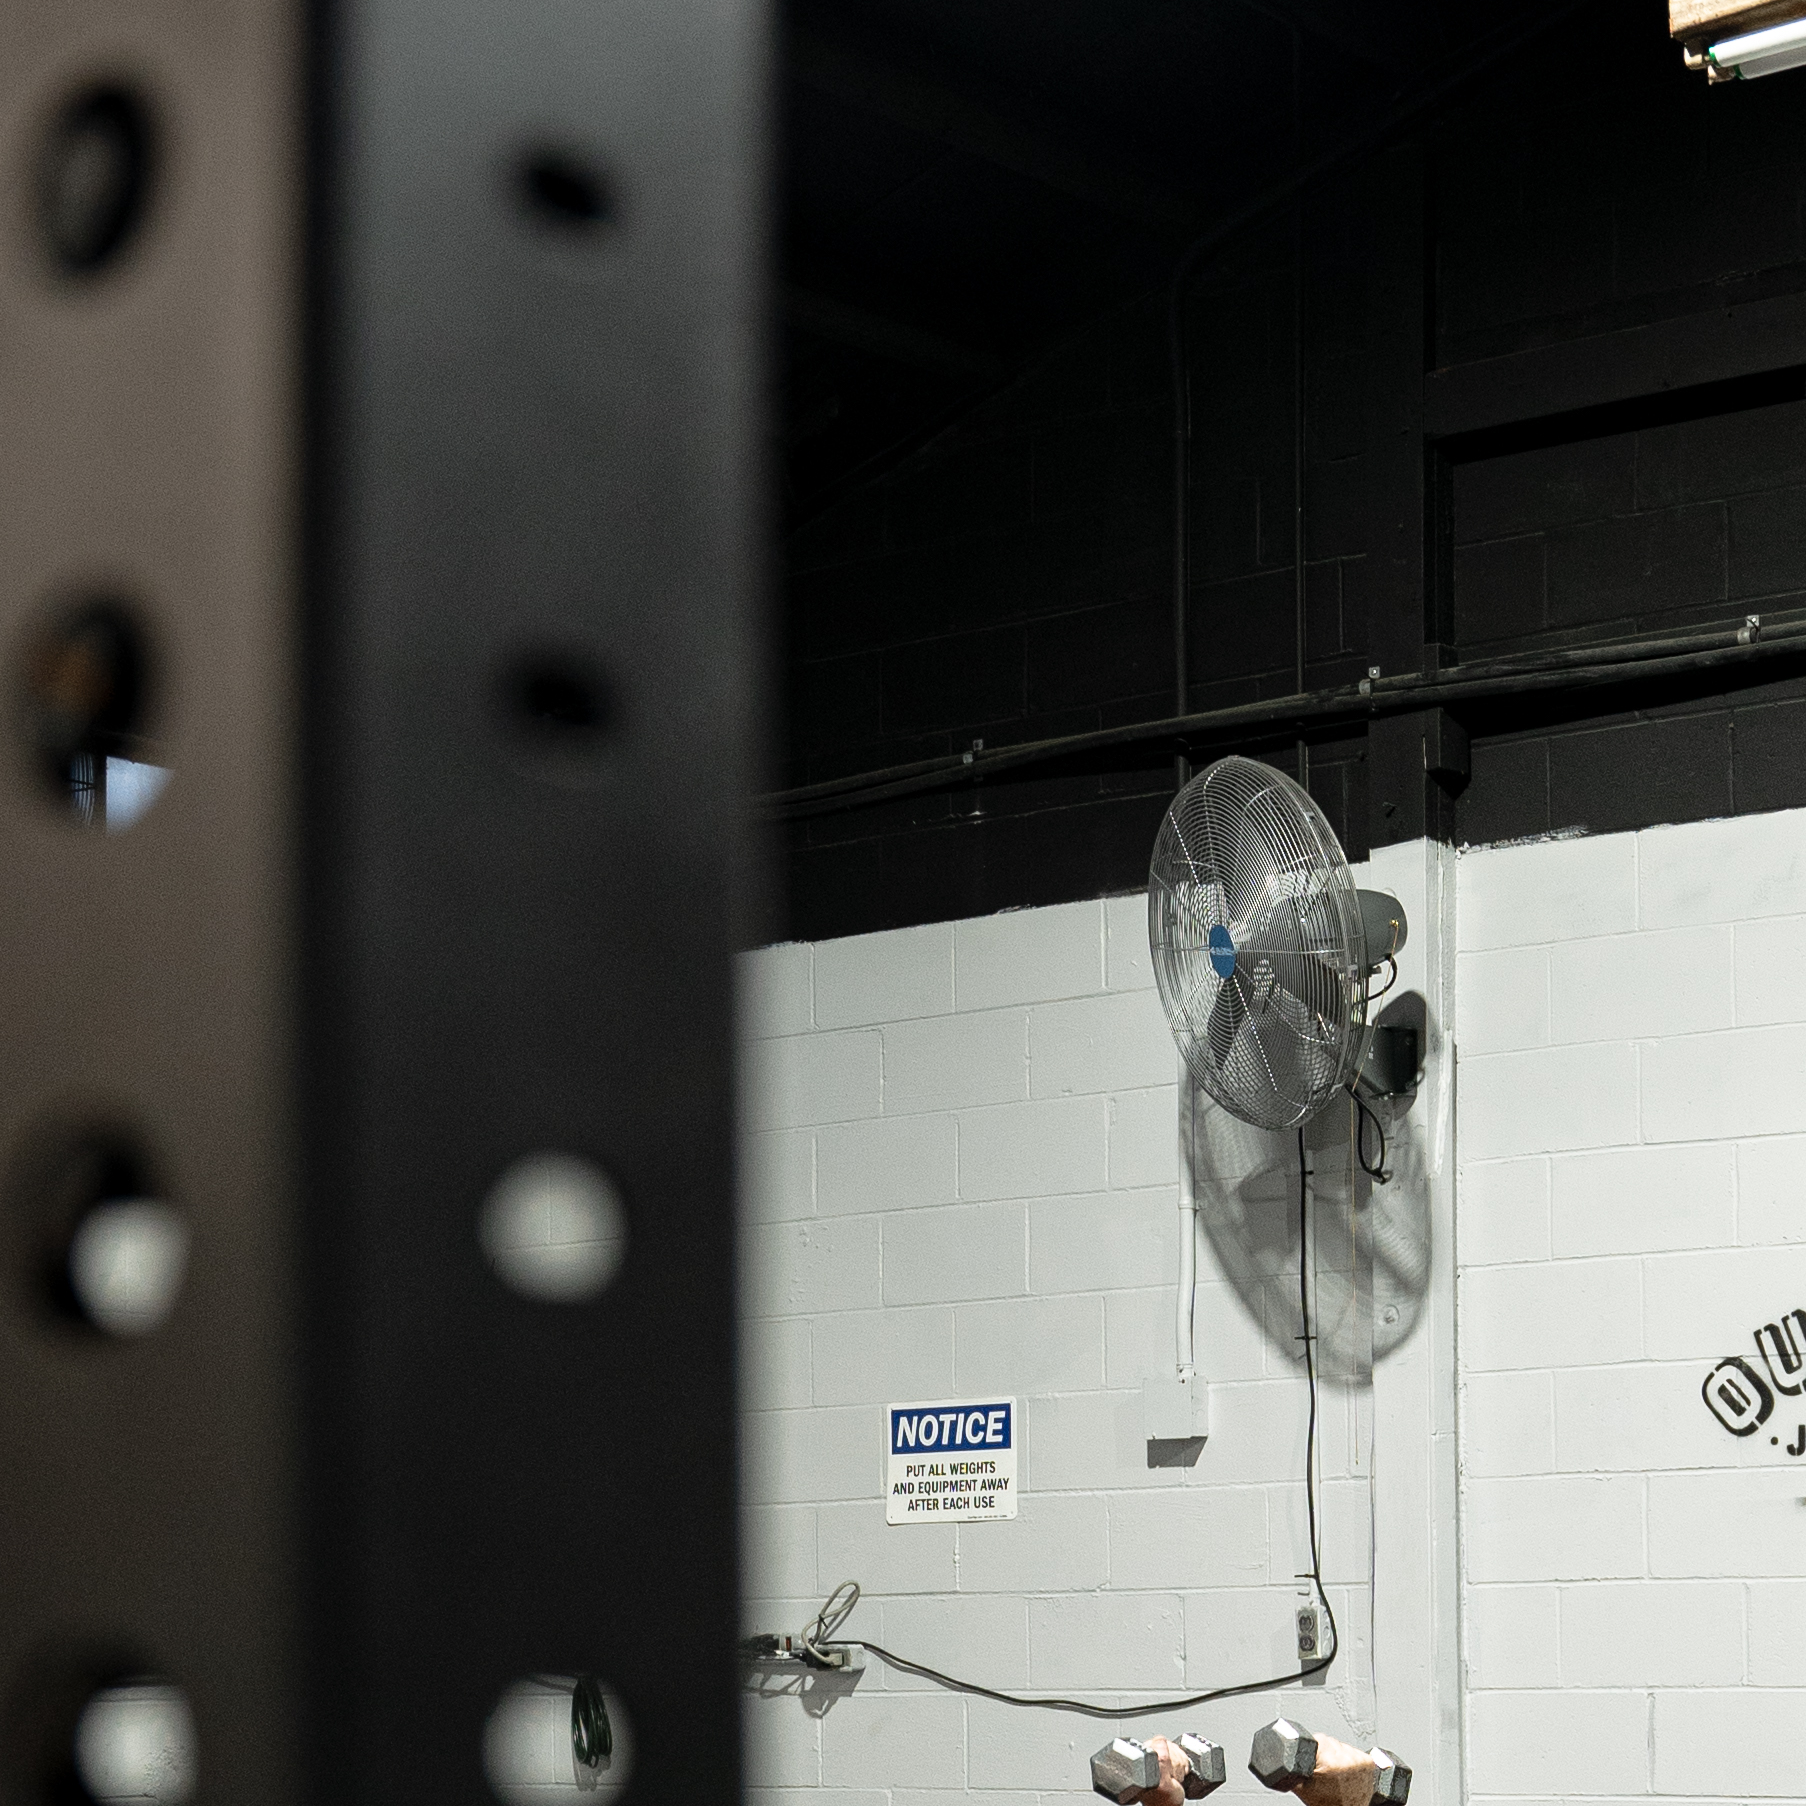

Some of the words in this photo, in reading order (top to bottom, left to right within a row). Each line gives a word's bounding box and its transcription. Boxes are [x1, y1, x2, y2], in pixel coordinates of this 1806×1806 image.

[896, 1410, 1006, 1448] NOTICE
[906, 1463, 926, 1478] PUT
[928, 1463, 946, 1476] ALL
[949, 1460, 996, 1475] WEIGHTS
[892, 1482, 915, 1495] AND
[918, 1479, 978, 1496] EQUIPMENT
[980, 1477, 1010, 1491] AWAY
[907, 1498, 939, 1512] AFTER
[943, 1496, 970, 1510] EACH
[973, 1495, 995, 1509] USE
